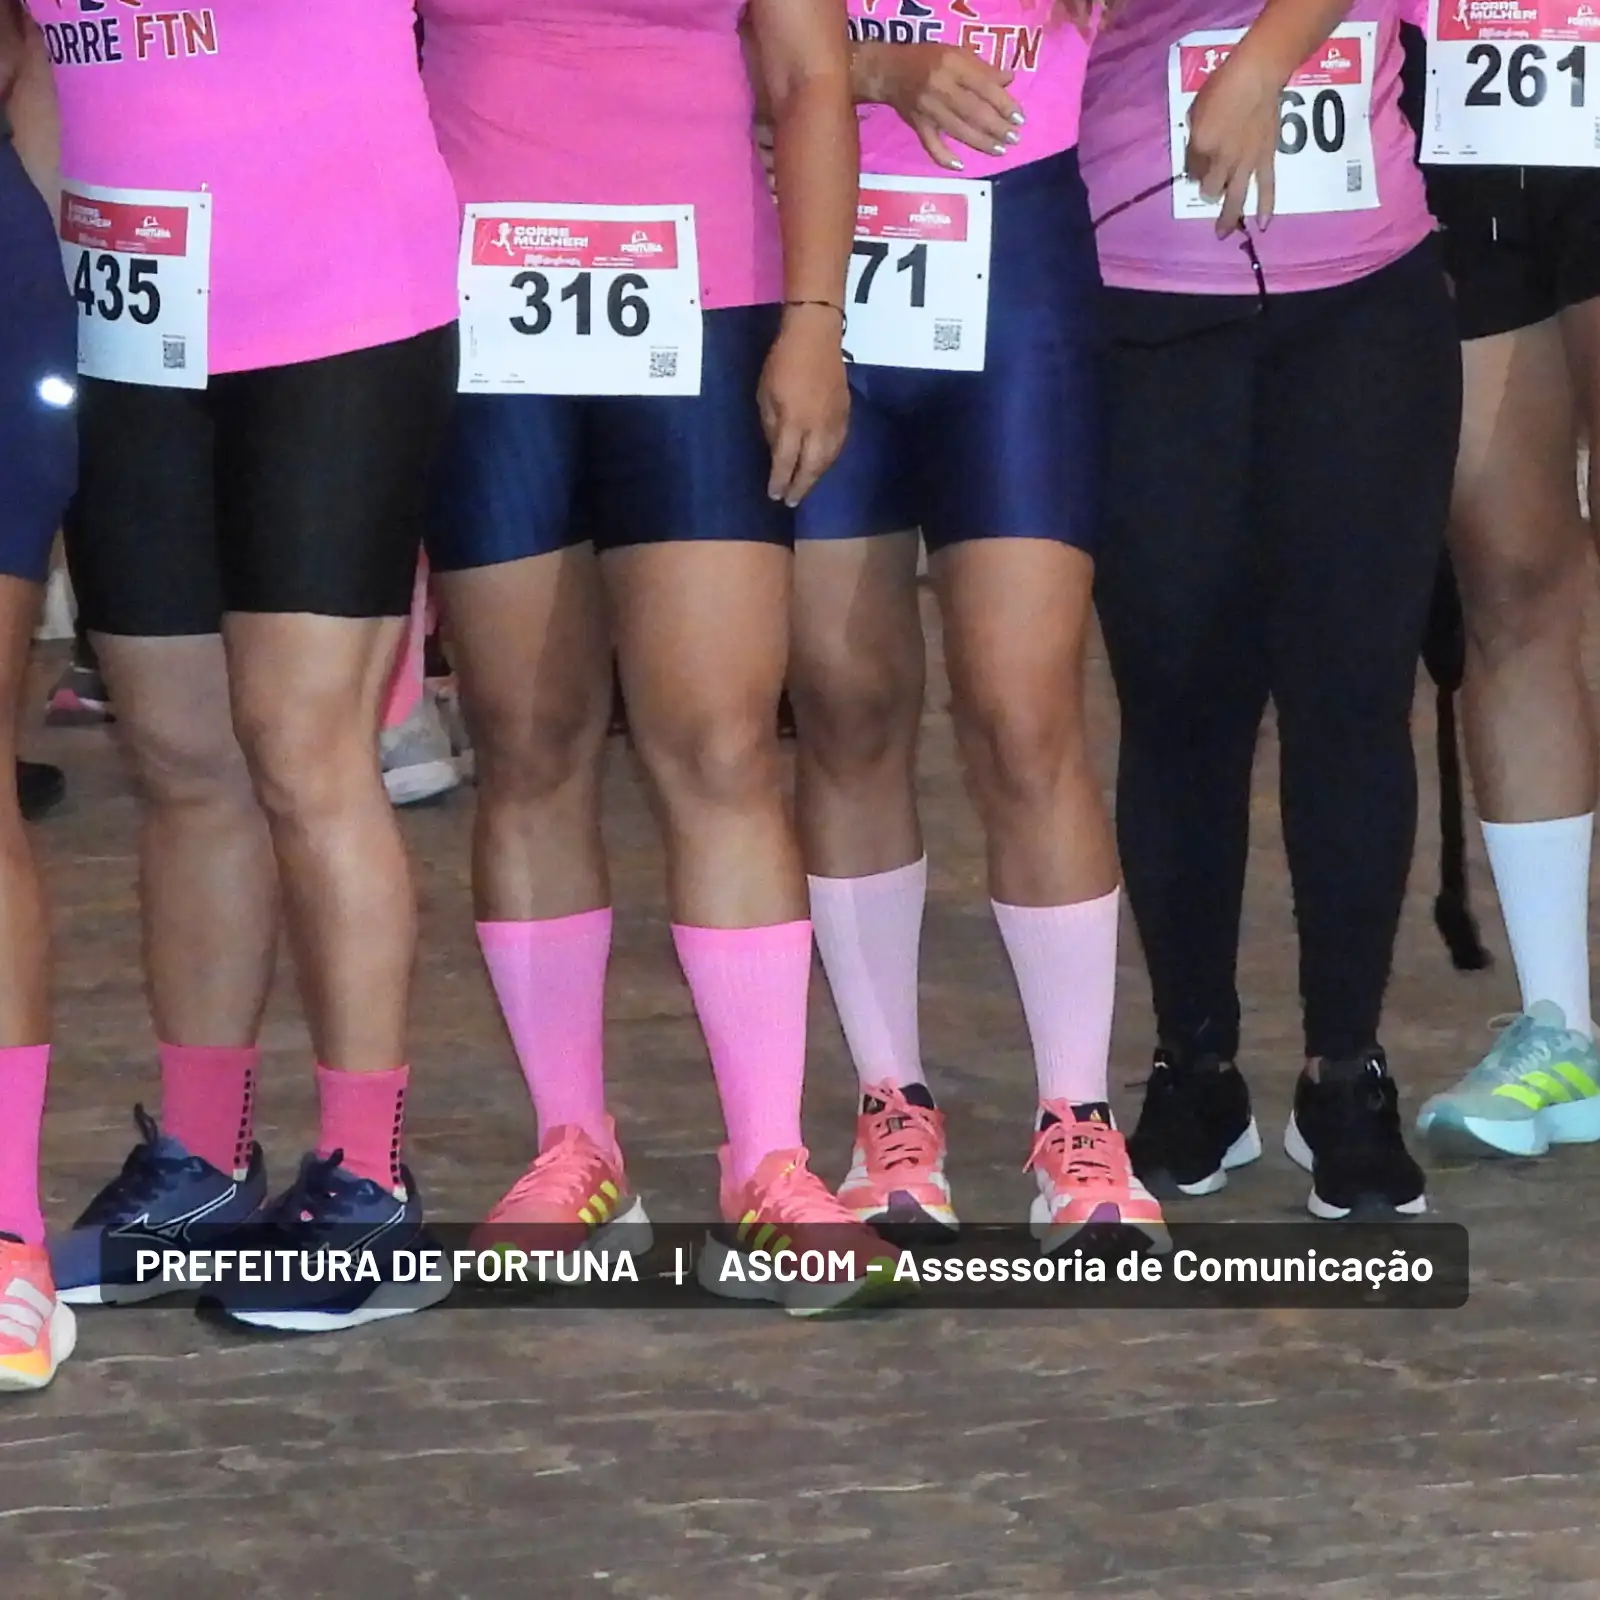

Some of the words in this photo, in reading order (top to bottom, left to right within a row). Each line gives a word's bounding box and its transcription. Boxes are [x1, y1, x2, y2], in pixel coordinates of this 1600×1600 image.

[45, 17, 123, 66] ORRE
[135, 9, 217, 59] FTN
[848, 17, 943, 45] RRE
[961, 24, 1043, 70] FTN
[1463, 43, 1586, 108] 261
[1275, 88, 1346, 155] 60
[73, 249, 161, 325] 435
[508, 270, 651, 338] 316
[851, 240, 928, 308] 71
